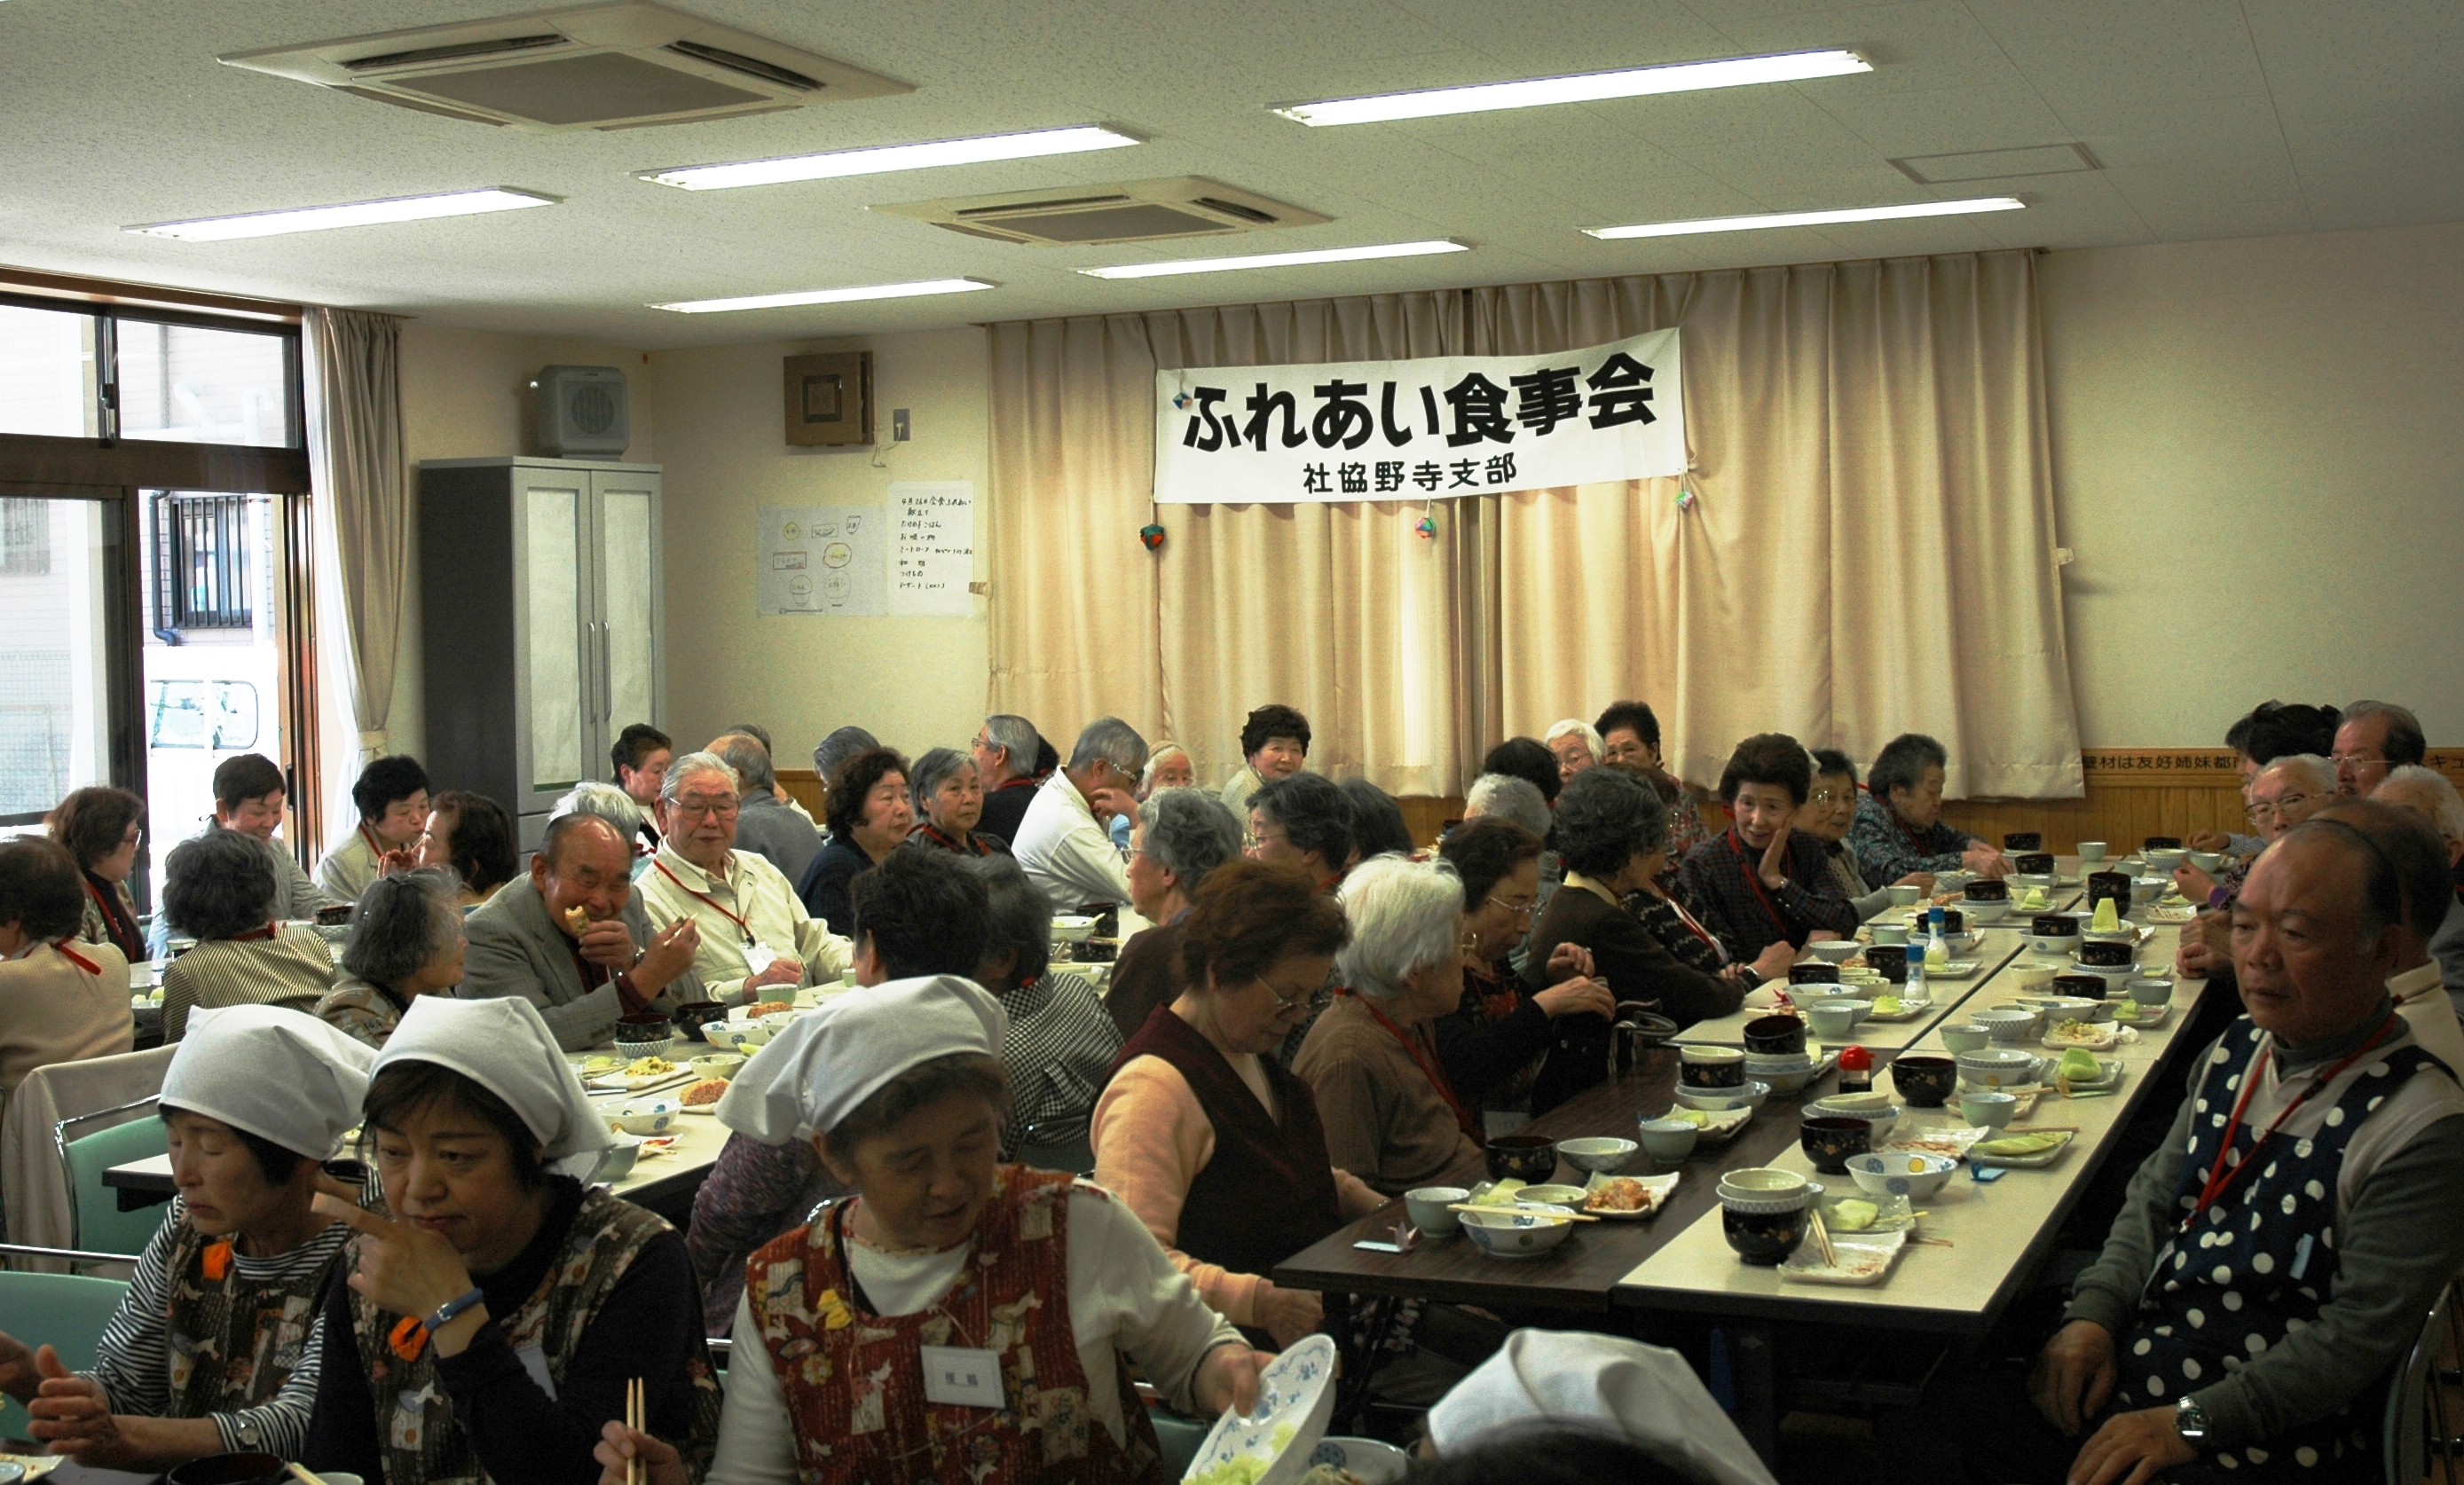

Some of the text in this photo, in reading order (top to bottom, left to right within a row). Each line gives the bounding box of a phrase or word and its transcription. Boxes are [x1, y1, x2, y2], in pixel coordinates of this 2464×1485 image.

[1183, 352, 1656, 452] ふれあい食事会
[1303, 452, 1517, 494] 社協野寺支部
